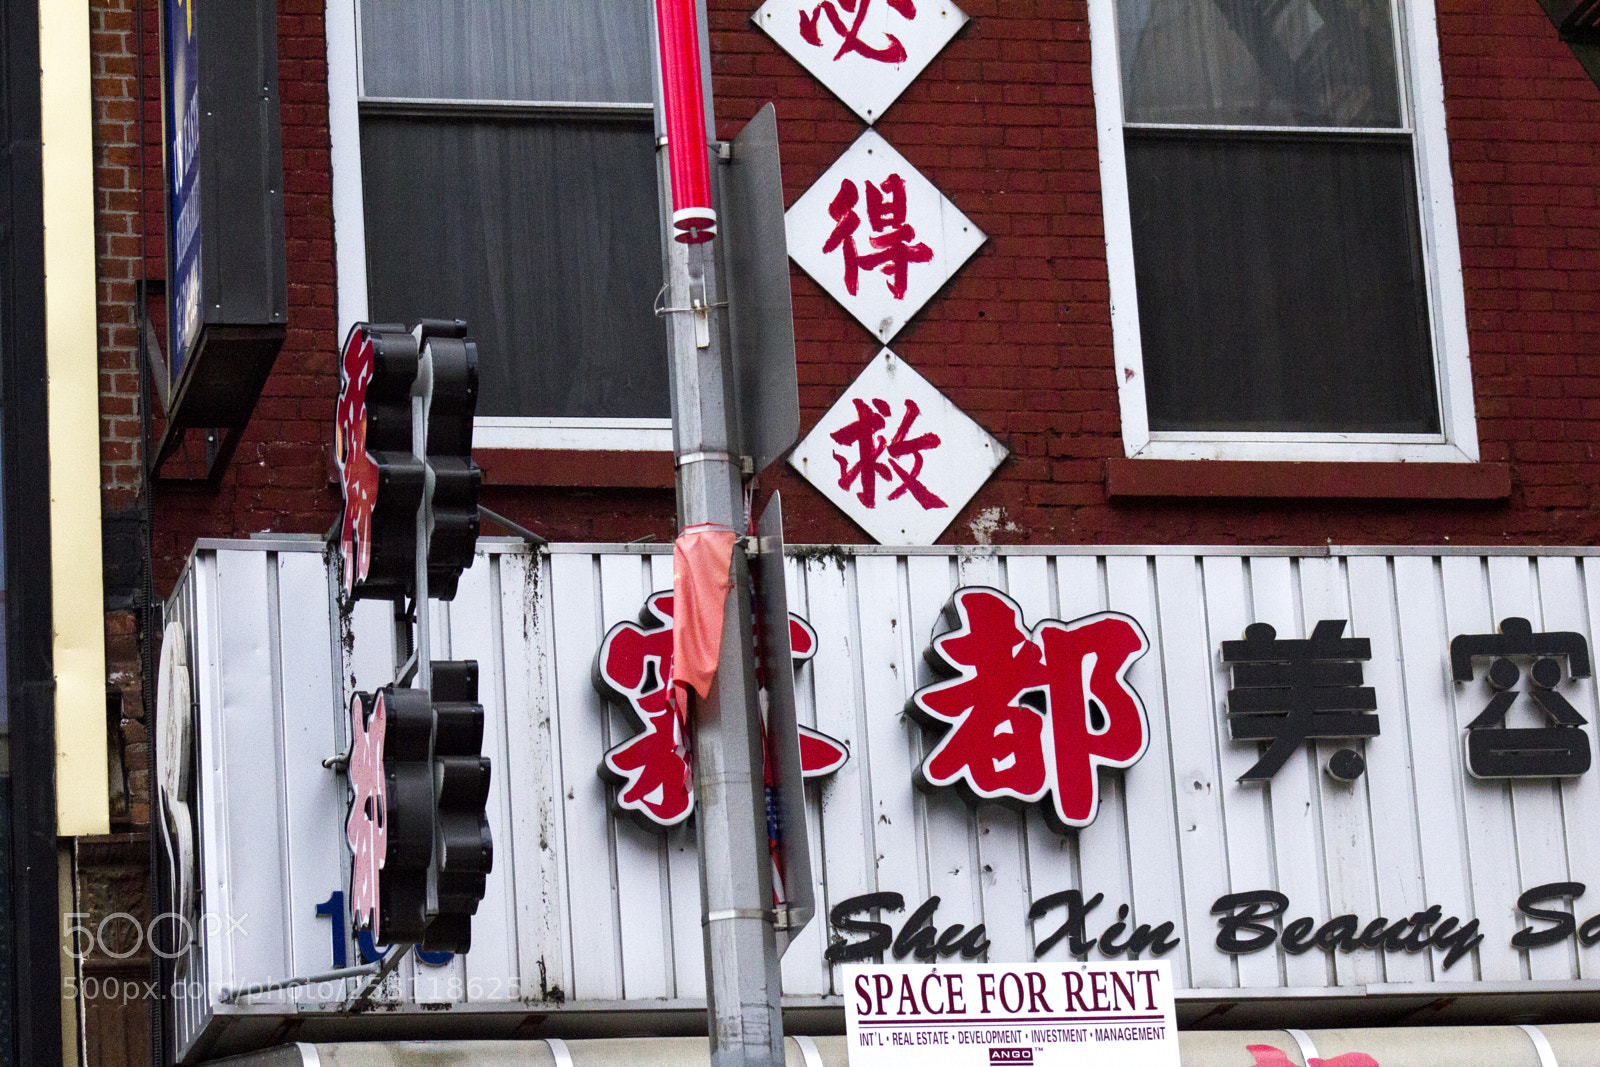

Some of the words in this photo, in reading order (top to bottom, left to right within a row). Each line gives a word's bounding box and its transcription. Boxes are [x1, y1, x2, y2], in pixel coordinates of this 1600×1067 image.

[826, 892, 991, 961] Shu
[1028, 889, 1180, 957] Xin
[1210, 889, 1485, 970] Beauty
[855, 973, 967, 1016] SPACE
[977, 972, 1054, 1014] FOR
[1061, 969, 1161, 1013] RENT
[859, 1032, 884, 1046] INT'L
[892, 1032, 914, 1046] REAL
[916, 1031, 949, 1045] ESTATE
[958, 1030, 1022, 1045] DEVELOPMENT
[1031, 1029, 1088, 1043] INVESTMENT
[1095, 1026, 1166, 1042] MANAGEMENT
[991, 1050, 1031, 1060] ANGO
